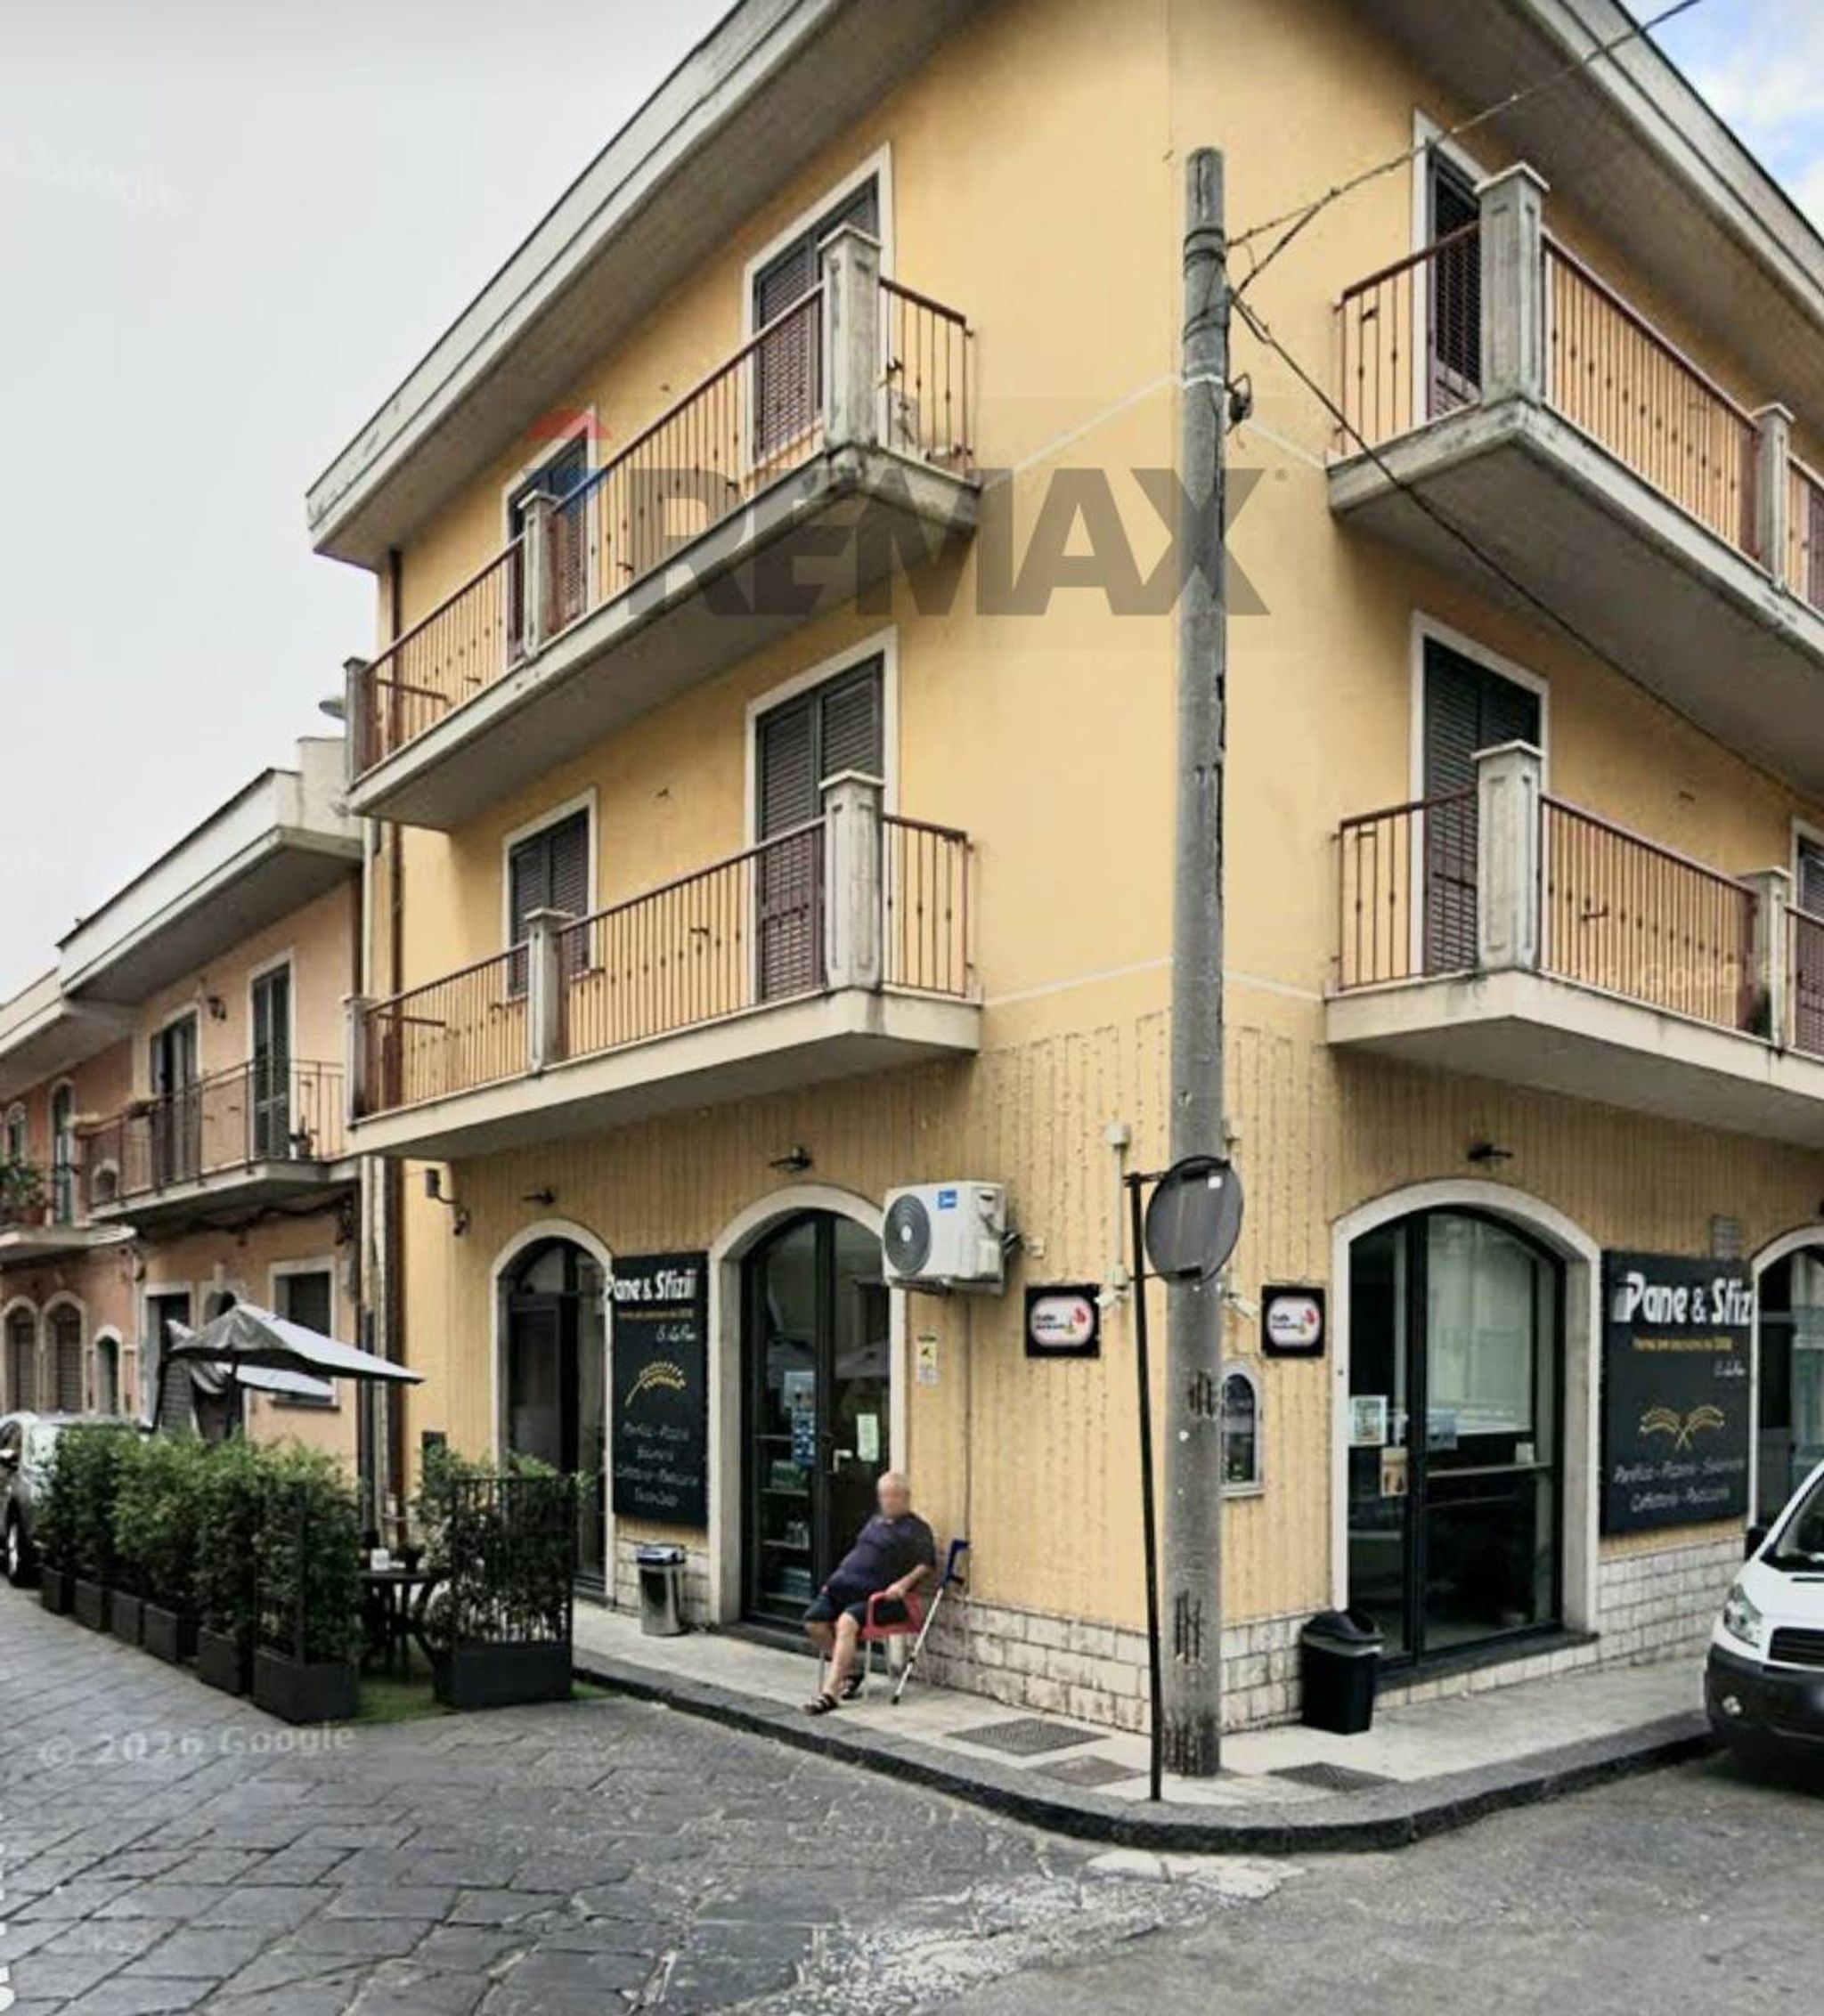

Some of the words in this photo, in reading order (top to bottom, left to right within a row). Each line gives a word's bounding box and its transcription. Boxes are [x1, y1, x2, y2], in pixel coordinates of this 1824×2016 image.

[1612, 1271, 1689, 1323] Pane
[1691, 1288, 1707, 1323] &
[1711, 1277, 1752, 1325] Sfiz
